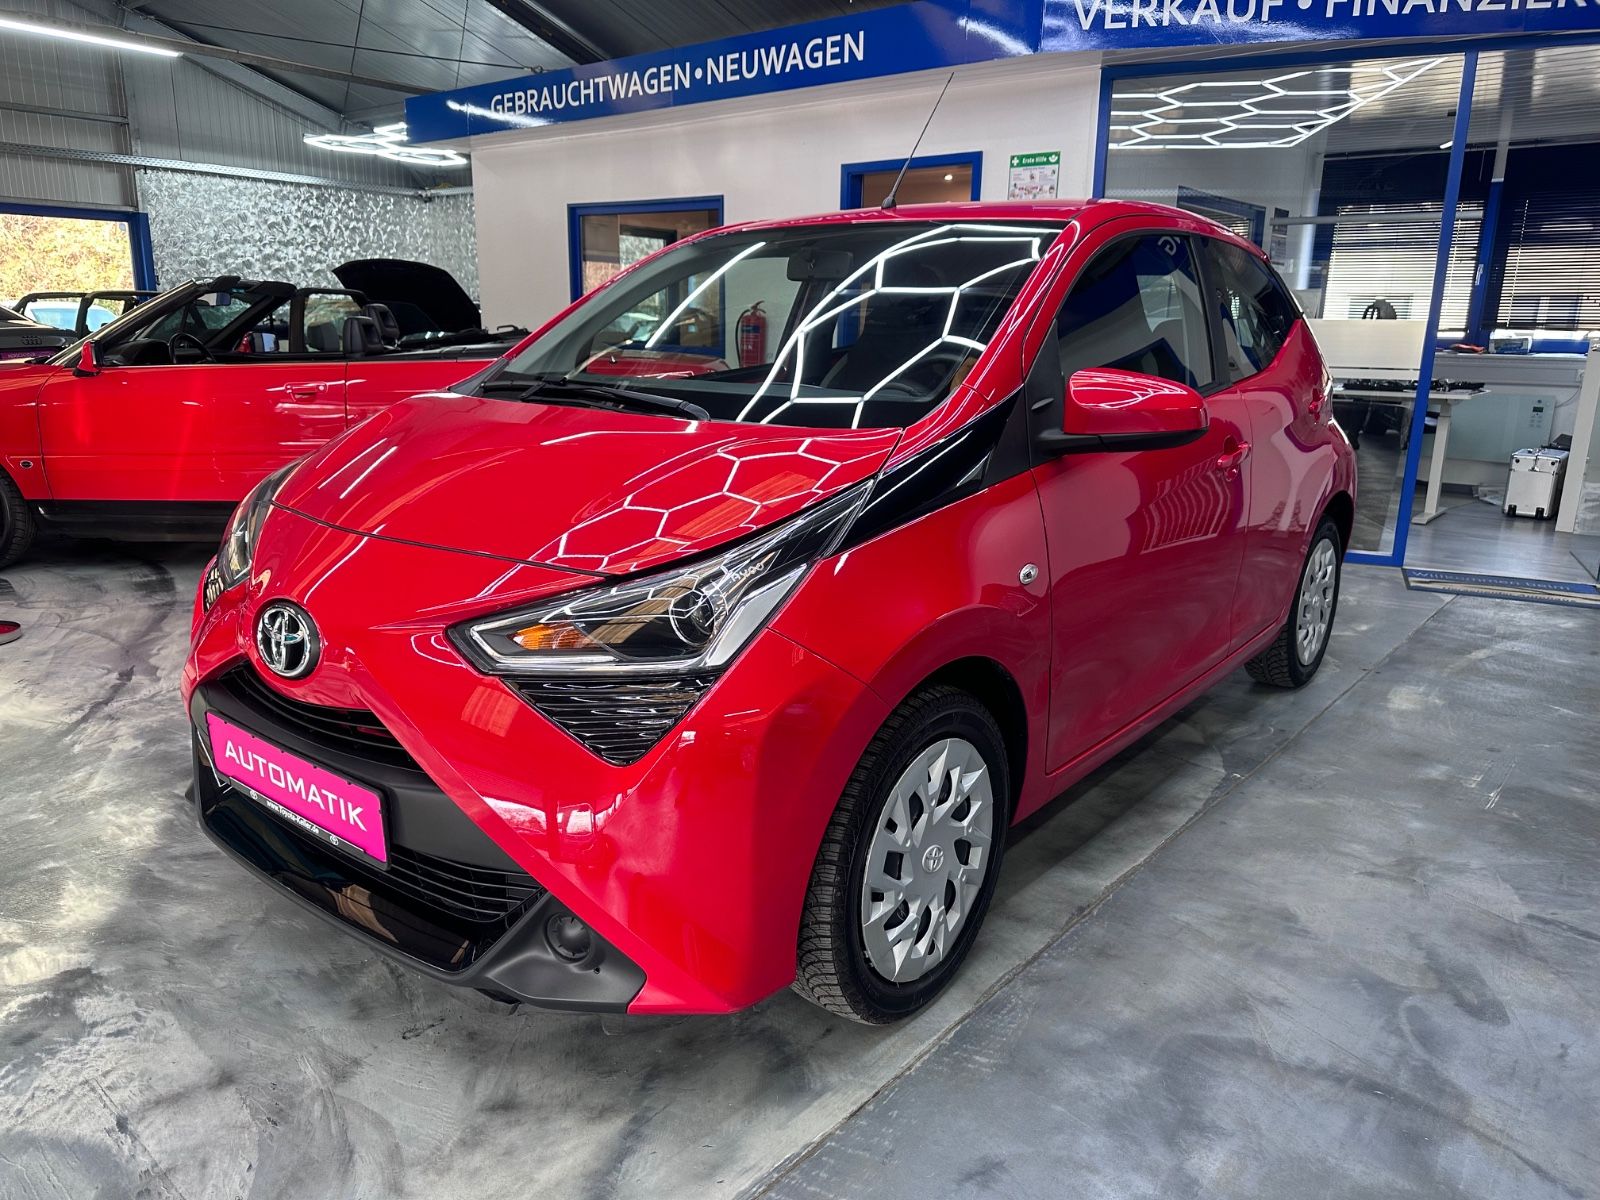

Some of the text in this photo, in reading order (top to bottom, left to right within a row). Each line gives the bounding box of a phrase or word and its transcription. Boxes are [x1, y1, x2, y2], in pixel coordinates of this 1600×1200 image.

[1074, 0, 1283, 31] VERKAUF
[490, 30, 865, 116] GEBRAUCHTWAGEN NEUWAGEN
[225, 740, 368, 831] AUTOMATIK
